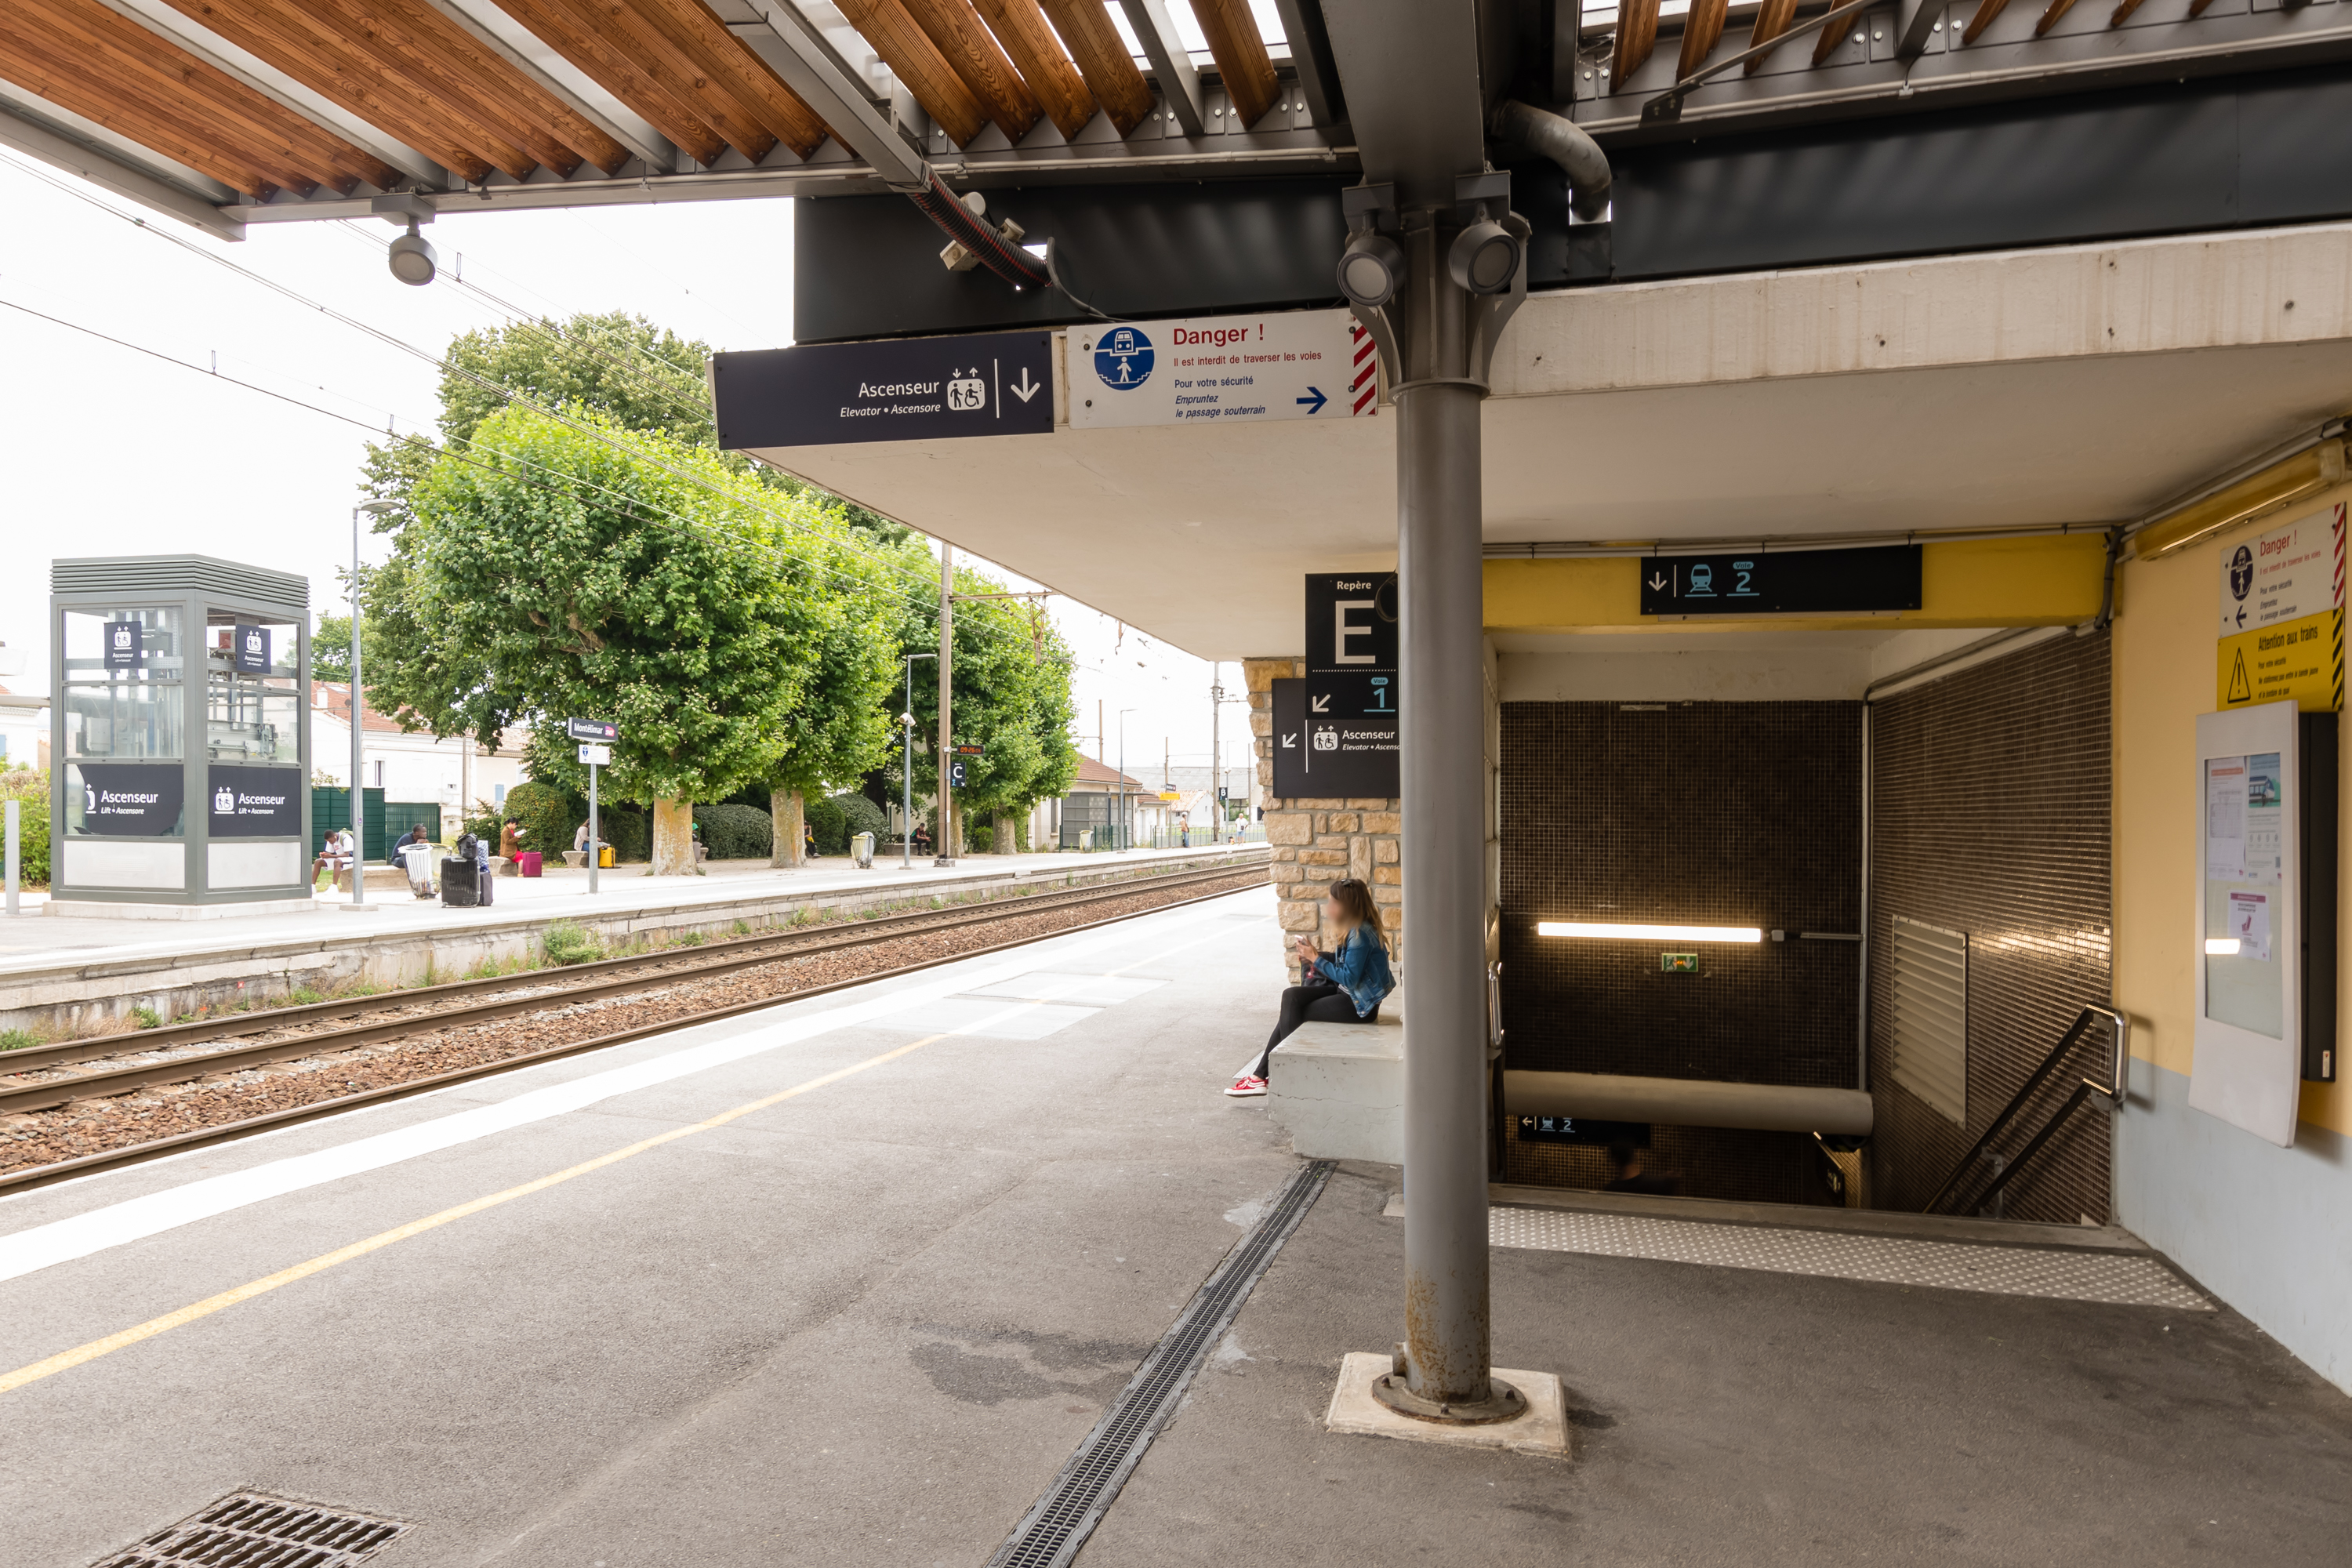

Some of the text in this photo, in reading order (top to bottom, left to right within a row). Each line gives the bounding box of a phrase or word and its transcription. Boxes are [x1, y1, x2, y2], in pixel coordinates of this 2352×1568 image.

[1174, 328, 1248, 347] Danger
[1181, 358, 1194, 366] est
[1197, 355, 1226, 365] interdit
[1229, 355, 1240, 364] de
[1243, 353, 1280, 364] traverser
[1283, 352, 1296, 361] les
[1299, 351, 1322, 361] voies
[1174, 376, 1254, 388] Pour votre sécurité
[858, 382, 939, 397] Ascenseur
[1175, 394, 1218, 405] Empruntez
[840, 404, 941, 417] Elevator Ascensore
[1175, 405, 1265, 419] le passage souterrain
[2259, 535, 2291, 557] Danger
[1337, 580, 1371, 591] Repère
[1736, 572, 1751, 592] 2
[1335, 600, 1376, 664] E
[2258, 625, 2318, 652] Attention aux trains
[1374, 688, 1385, 708] 1
[574, 722, 603, 734] Montélimar
[1342, 729, 1395, 739] Ascenseur
[953, 766, 963, 778] C
[100, 790, 158, 803] Ascenseur
[238, 793, 285, 804] Ascenseur
[1563, 1120, 1571, 1131] 2
